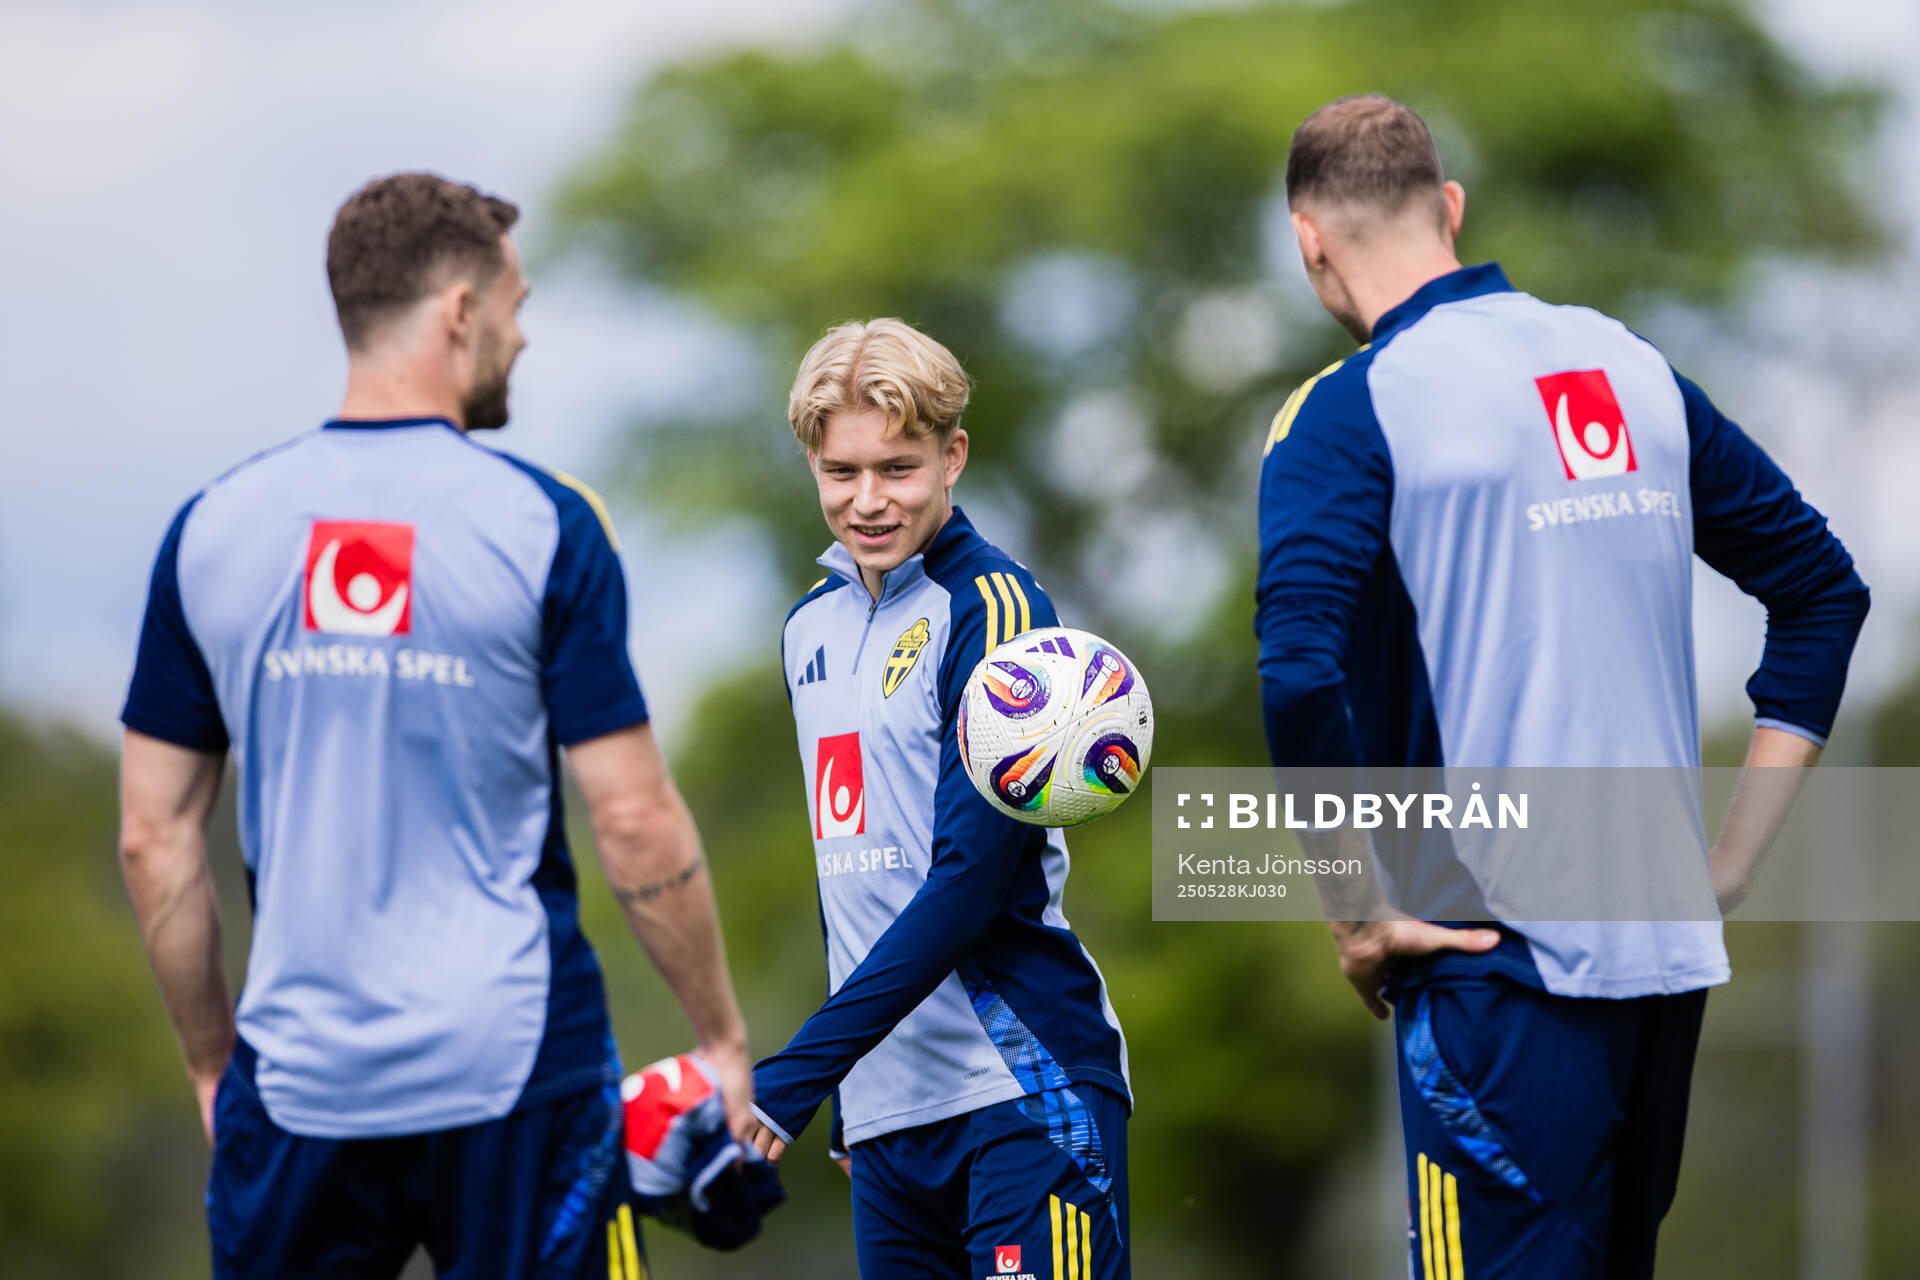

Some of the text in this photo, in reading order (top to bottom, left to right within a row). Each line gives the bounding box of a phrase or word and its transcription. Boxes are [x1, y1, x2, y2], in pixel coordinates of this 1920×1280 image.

[1526, 488, 1682, 531] SVENSKA SPEL
[263, 645, 475, 688] SVNSKA SPEL
[858, 846, 913, 873] SPEL
